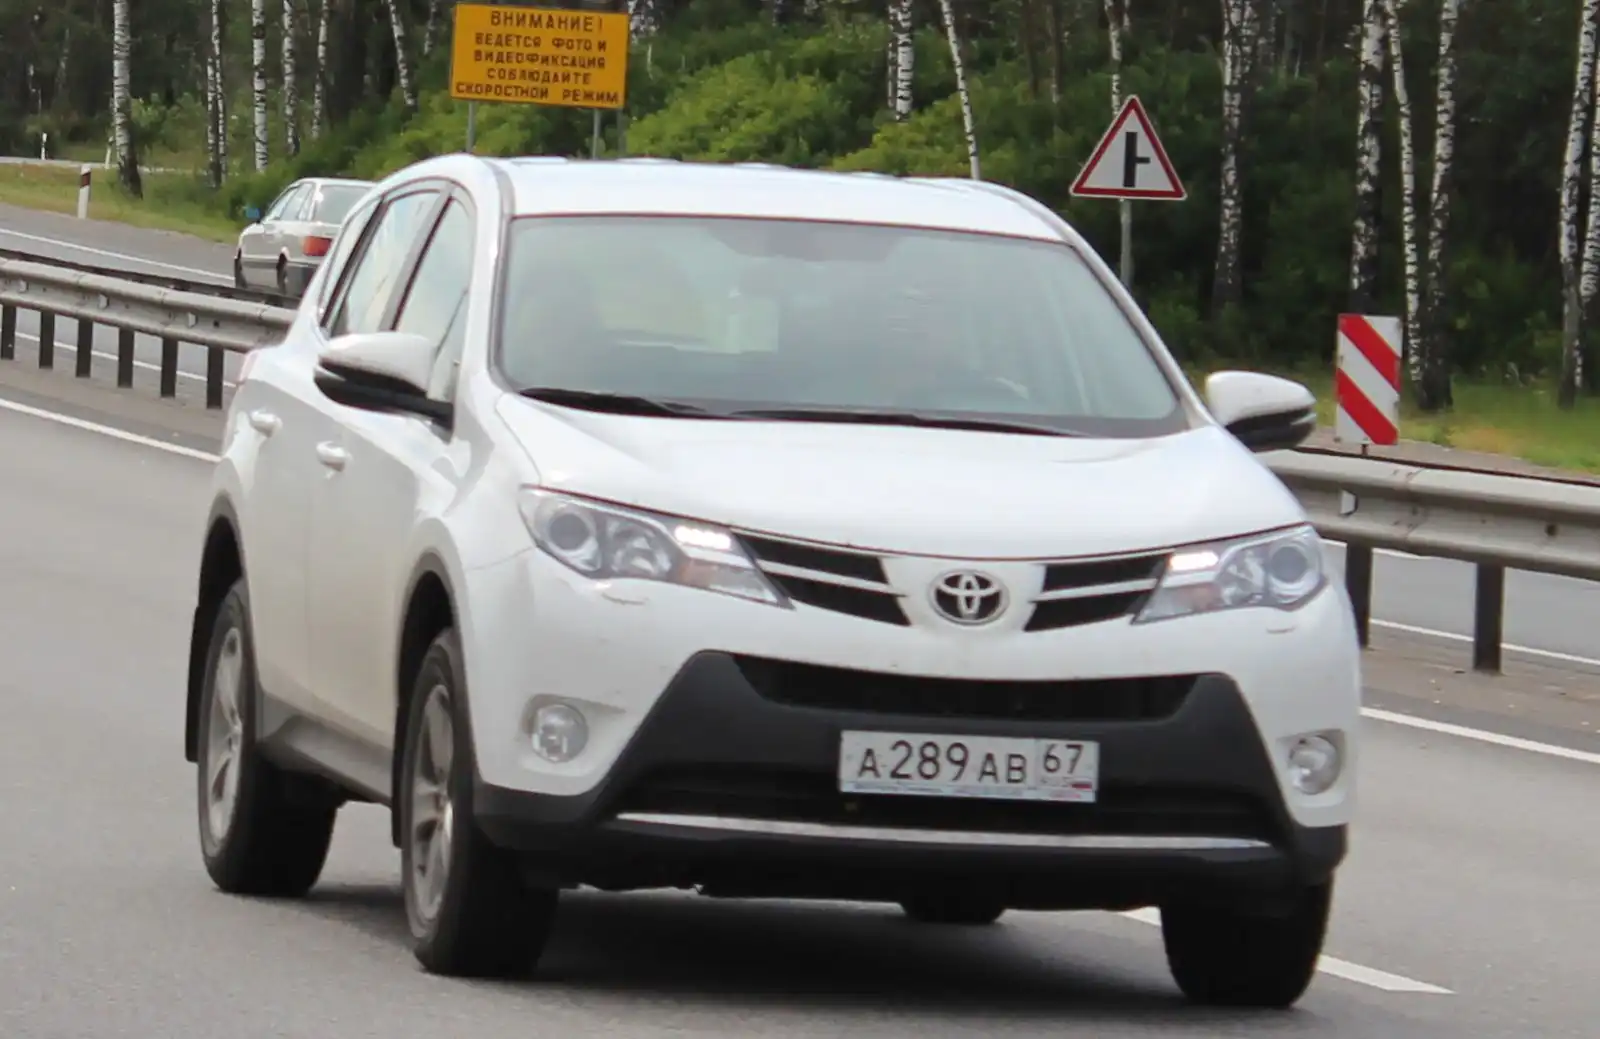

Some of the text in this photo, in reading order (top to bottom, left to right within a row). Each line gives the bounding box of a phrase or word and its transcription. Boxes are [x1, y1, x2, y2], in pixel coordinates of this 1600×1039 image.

[551, 37, 593, 51] ФОТО
[597, 40, 607, 52] И
[474, 50, 605, 69] ВИДЕОФИКСАЦИЯ
[562, 88, 619, 104] РЕЖИМ
[1043, 744, 1084, 774] 67
